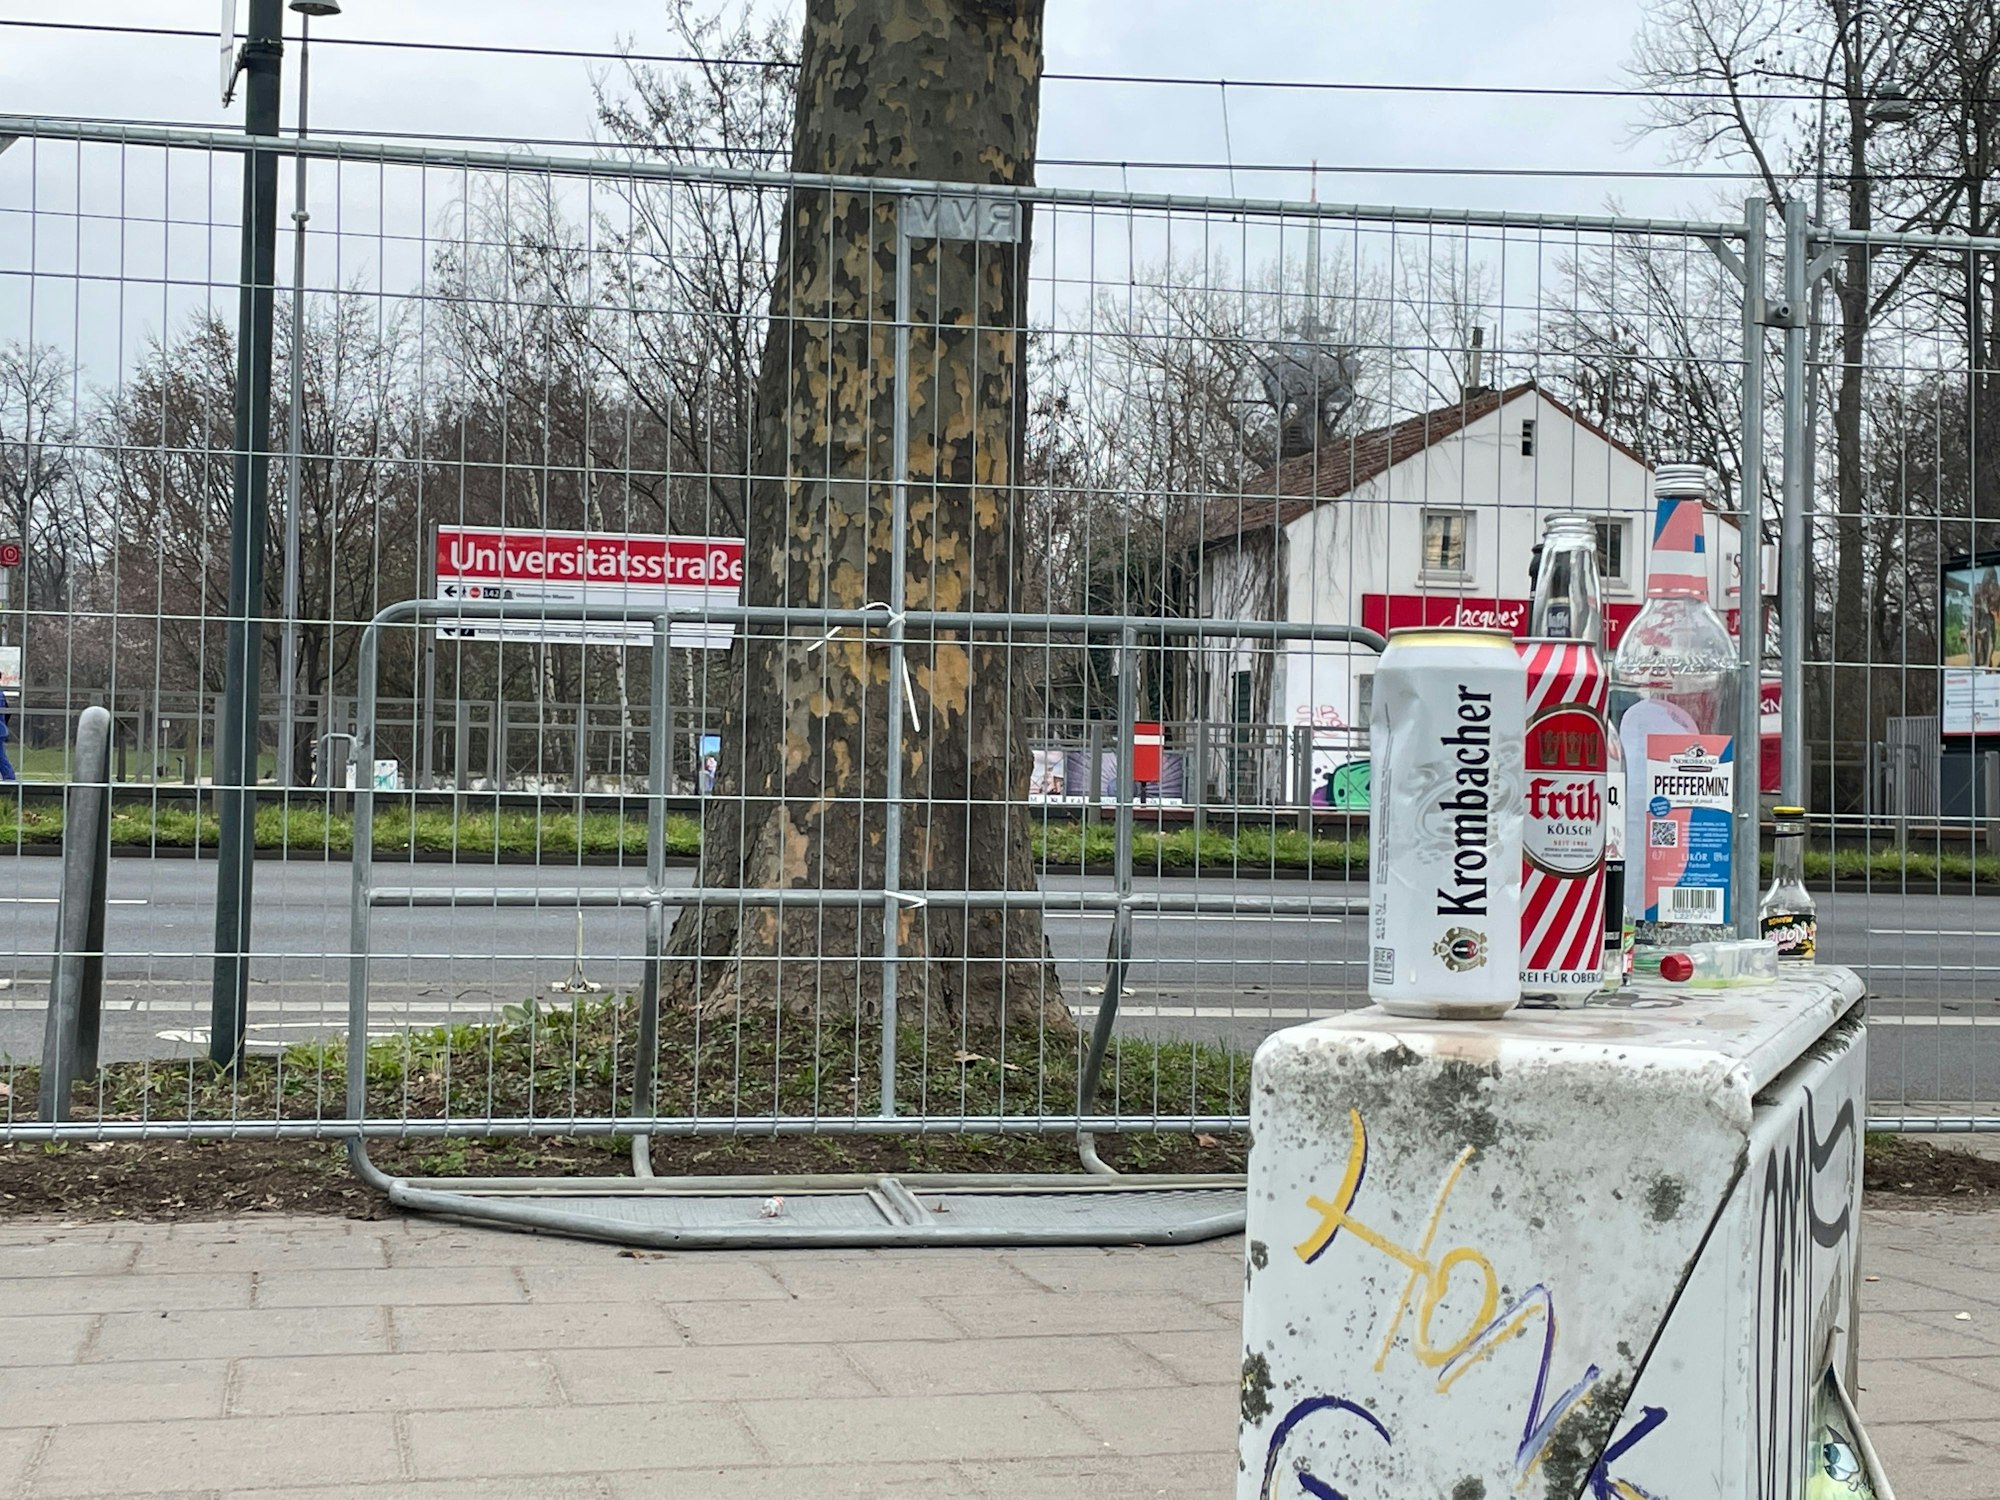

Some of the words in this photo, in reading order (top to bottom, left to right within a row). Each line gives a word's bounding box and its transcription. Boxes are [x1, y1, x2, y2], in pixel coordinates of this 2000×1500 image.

[450, 540, 744, 582] Universitätsstraße
[483, 587, 500, 598] 142
[1654, 775, 1729, 797] PFEFFERMINZ
[1437, 684, 1492, 916] Krombacher
[1547, 823, 1593, 836] KÖLSCH
[1543, 970, 1568, 984] FÜR
